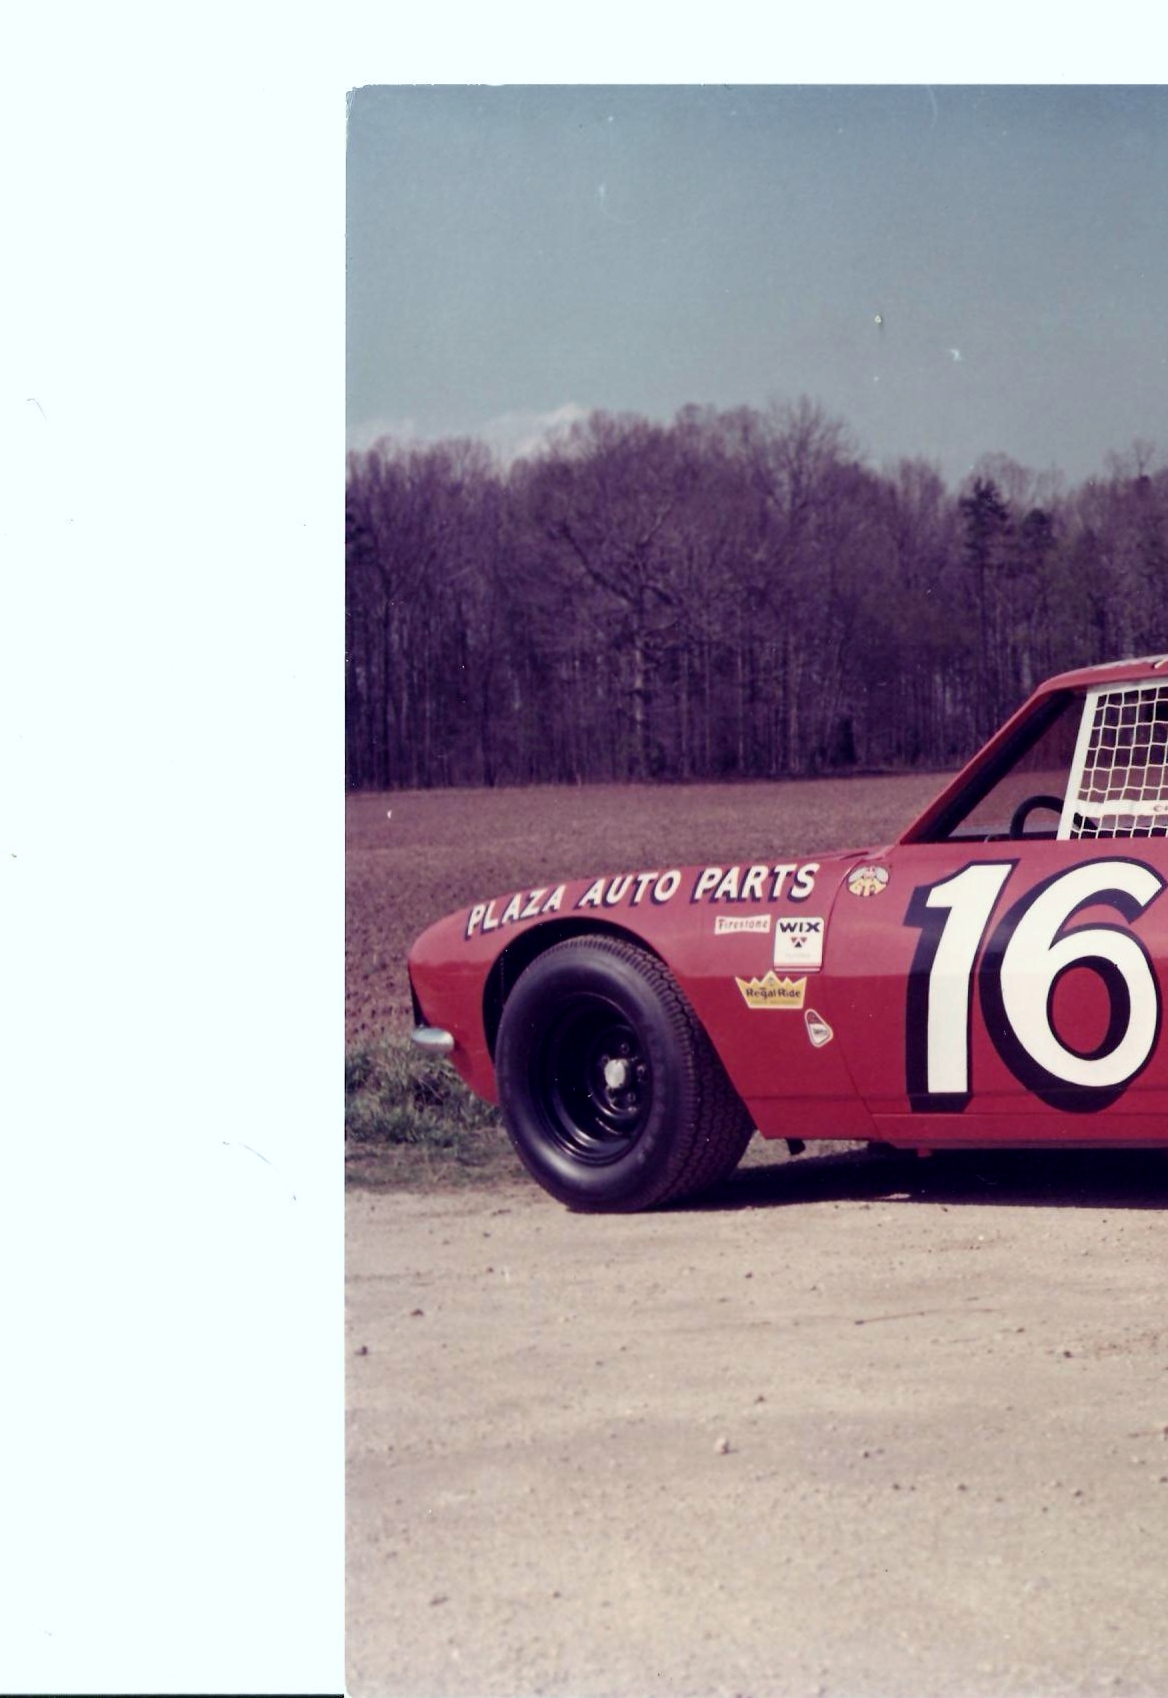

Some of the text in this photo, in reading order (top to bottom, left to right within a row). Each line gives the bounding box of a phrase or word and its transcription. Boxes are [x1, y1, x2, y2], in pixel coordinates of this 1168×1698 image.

[465, 862, 821, 937] PLAZA AUTO PARTS
[718, 919, 769, 931] Firestone
[779, 921, 821, 933] WIX
[904, 857, 1168, 1113] 16
[745, 986, 802, 1000] Regal Ride
